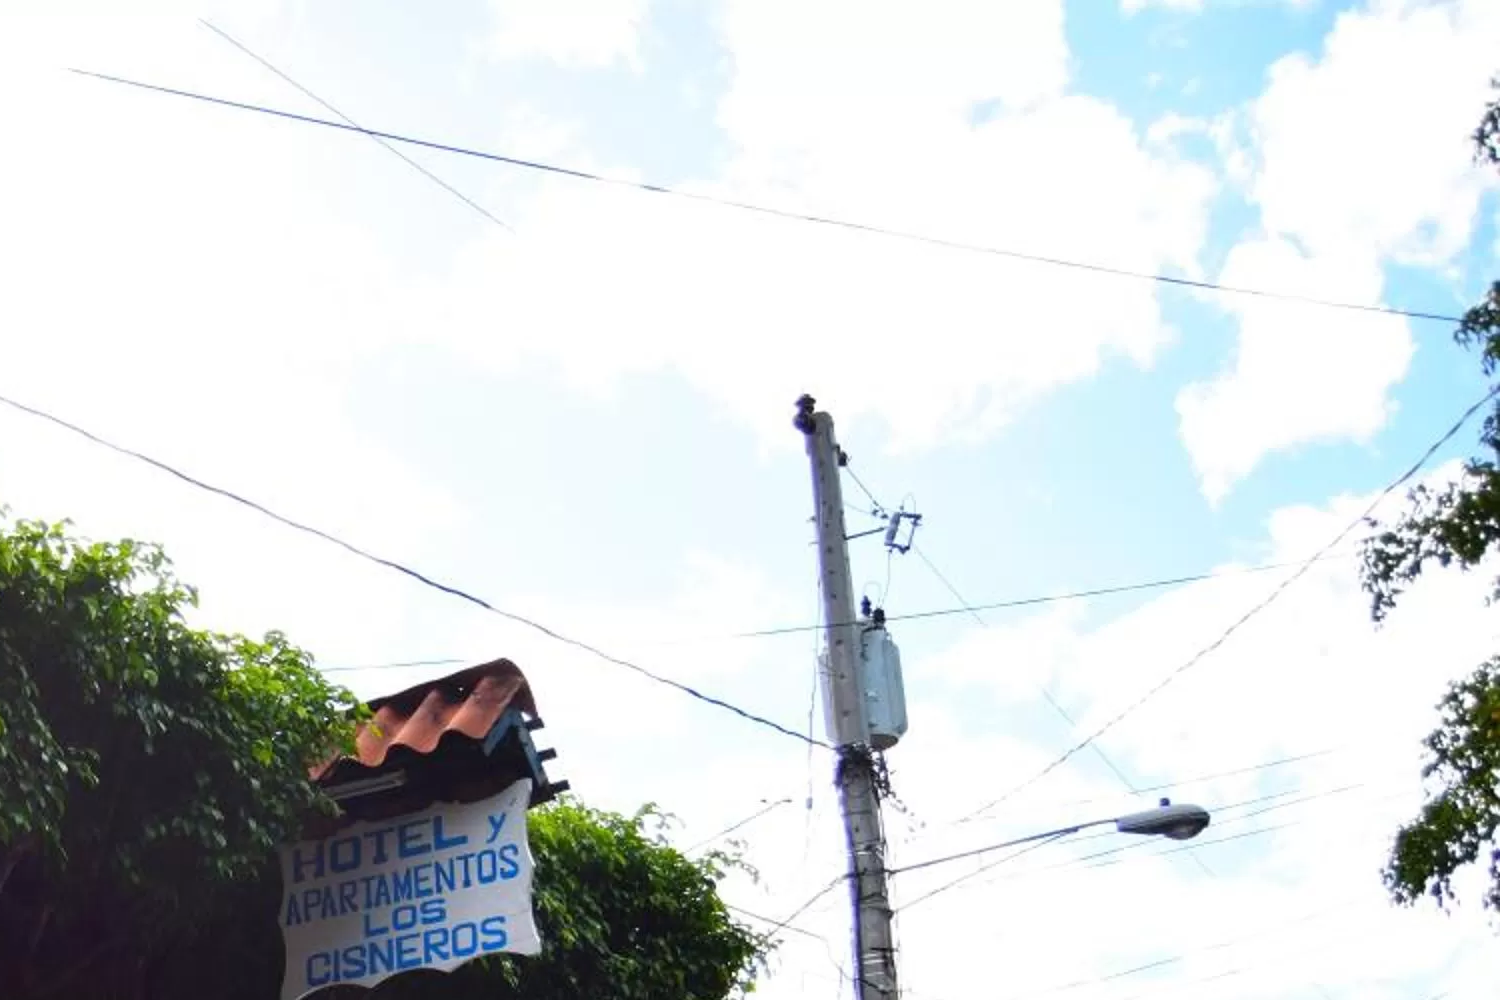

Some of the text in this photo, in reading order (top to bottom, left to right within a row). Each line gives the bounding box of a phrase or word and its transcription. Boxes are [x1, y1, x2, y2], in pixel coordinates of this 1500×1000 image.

[293, 815, 468, 882] HOTEL
[286, 843, 519, 926] APARTAMENTOS
[364, 898, 447, 938] LOS
[306, 916, 508, 987] CISNEROS
